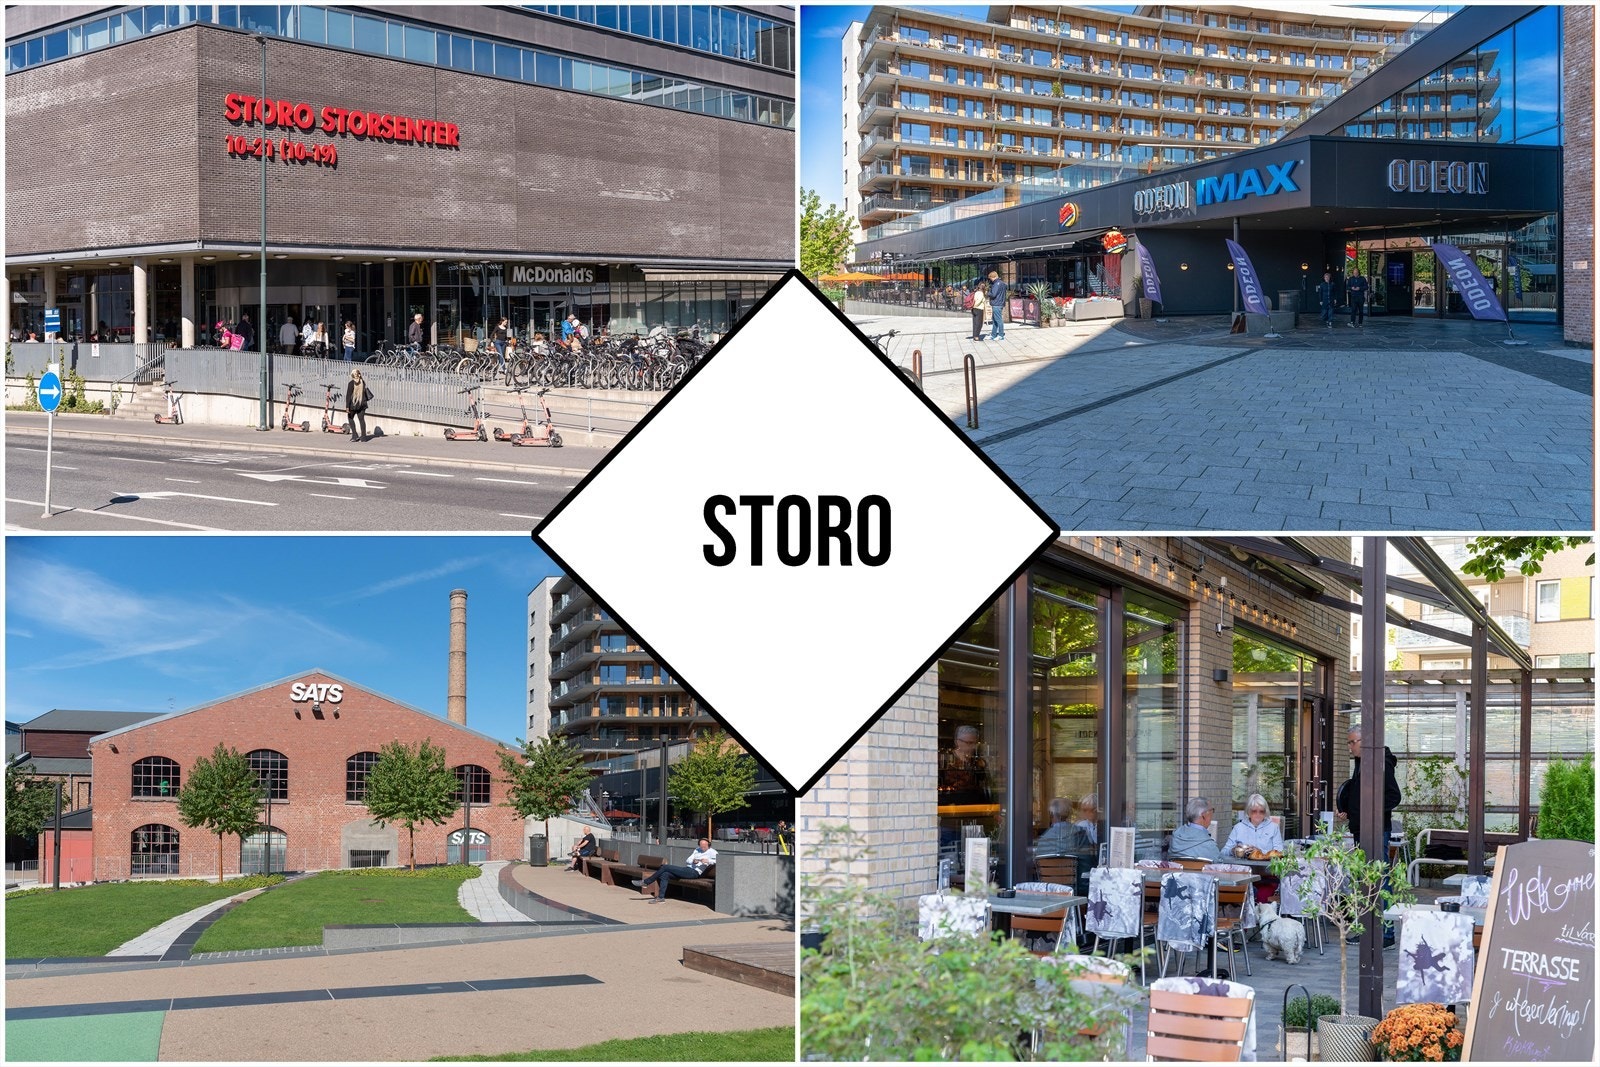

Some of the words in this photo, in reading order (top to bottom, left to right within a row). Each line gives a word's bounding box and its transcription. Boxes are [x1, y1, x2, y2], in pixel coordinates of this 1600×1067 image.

[224, 92, 314, 130] STORO
[320, 105, 460, 147] STORSENTER
[225, 134, 273, 158] 10-21
[279, 137, 338, 165] (10-19)
[1134, 180, 1190, 216] ODEON
[1196, 159, 1301, 207] IMAX
[1387, 158, 1490, 195] ODEON
[512, 265, 594, 284] McDonald's
[1141, 256, 1157, 294] ODEON
[1236, 257, 1261, 305] ODEON
[1447, 257, 1491, 311] ODEON
[290, 682, 344, 703] SATS
[1501, 947, 1580, 982] TERRASSE
